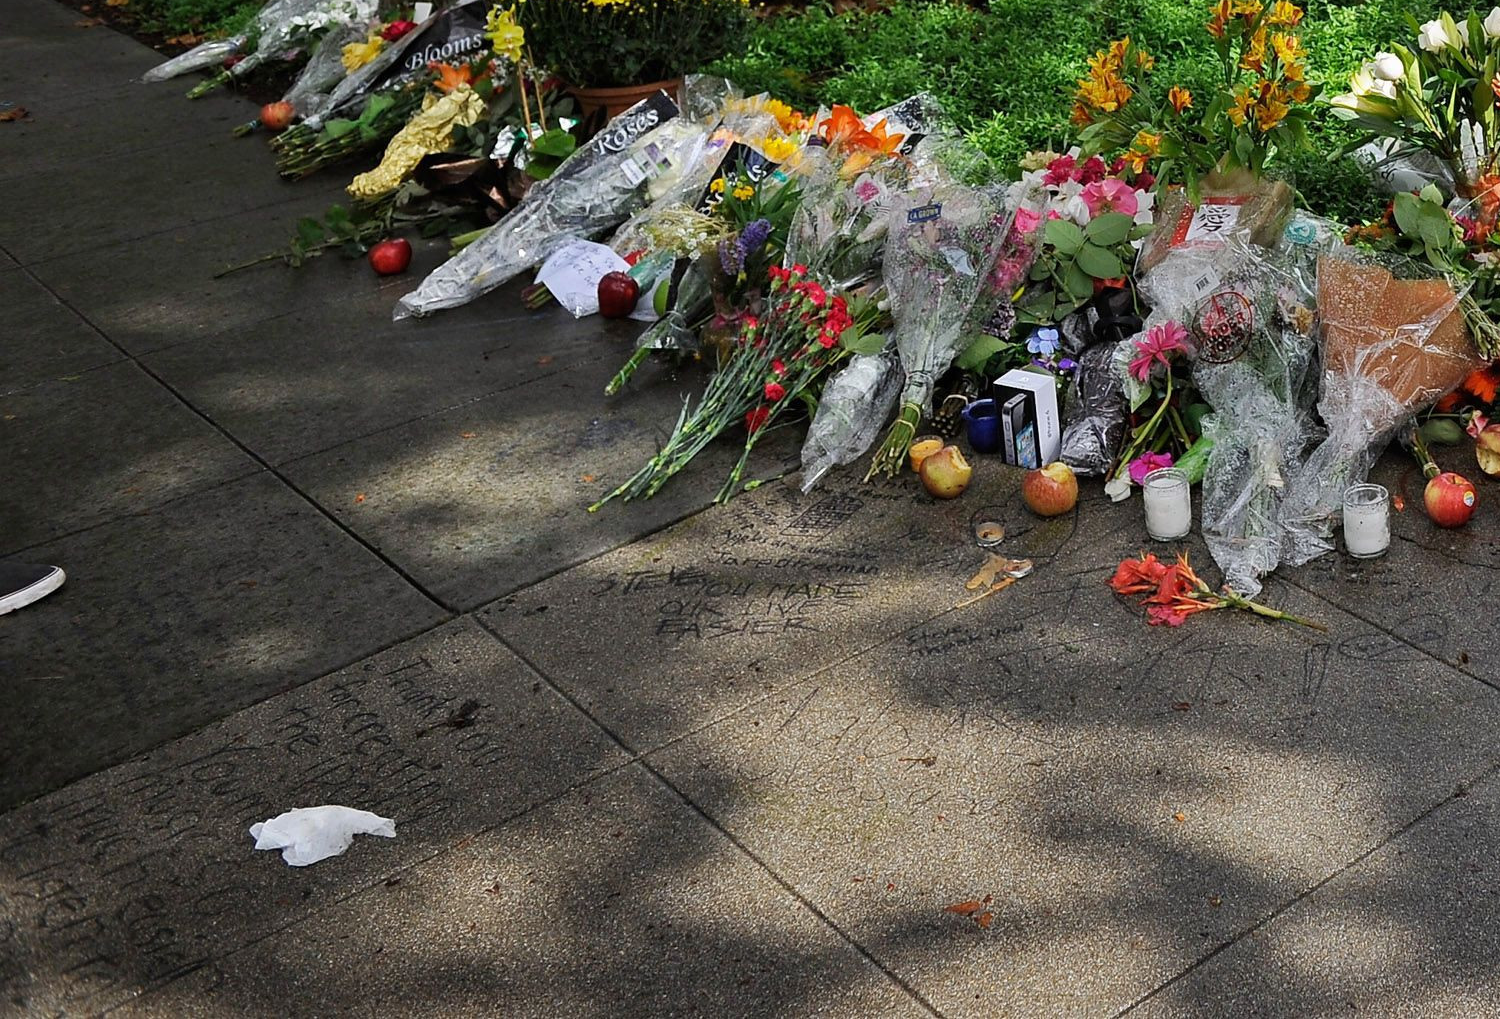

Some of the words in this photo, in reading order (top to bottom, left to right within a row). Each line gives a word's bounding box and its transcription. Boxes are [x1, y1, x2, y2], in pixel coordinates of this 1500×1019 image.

[404, 33, 482, 70] Blooms
[592, 109, 660, 156] Roses
[592, 566, 705, 596] STEVE
[697, 581, 752, 597] YOU
[766, 582, 868, 600] MADE
[658, 600, 724, 617] OUR
[656, 617, 820, 640] EASIER
[384, 657, 458, 720] Thank
[262, 702, 336, 757] the
